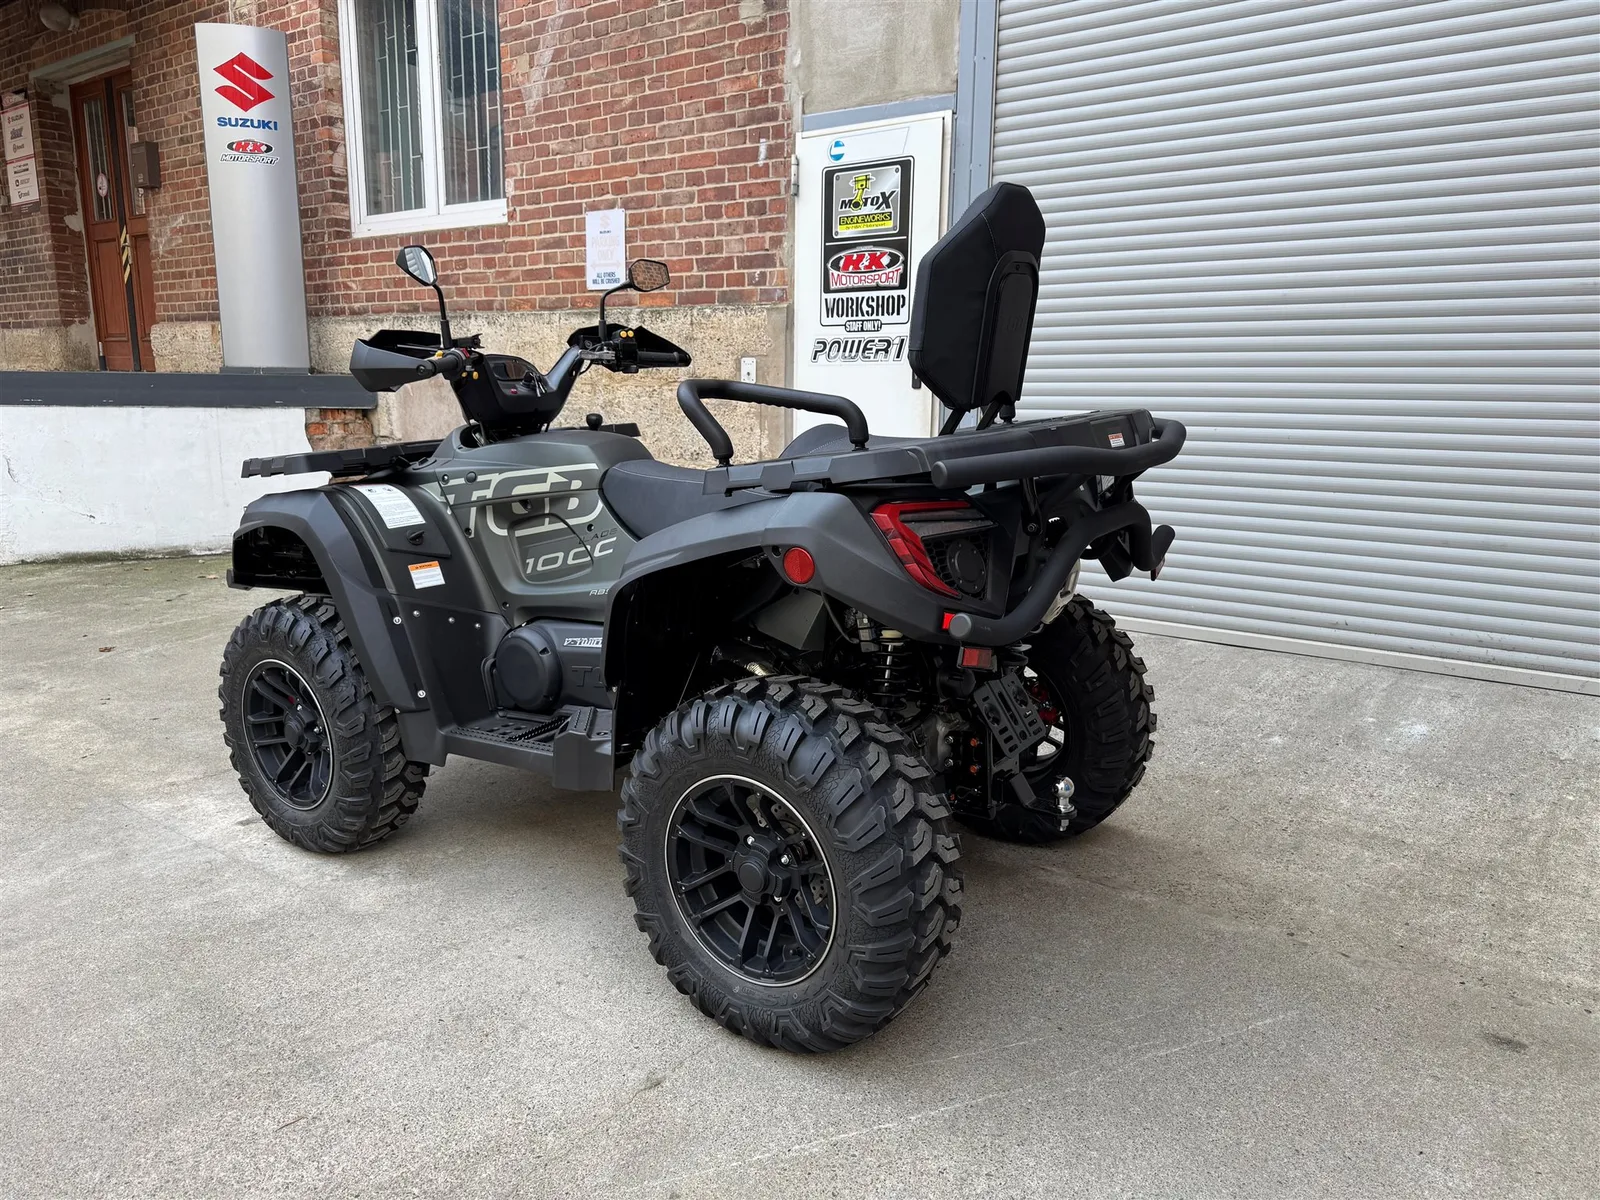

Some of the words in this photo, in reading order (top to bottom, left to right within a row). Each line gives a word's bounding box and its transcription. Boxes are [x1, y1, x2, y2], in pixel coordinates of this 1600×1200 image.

[217, 116, 278, 131] SUZUKI
[220, 153, 280, 166] MOTORSPORT
[840, 212, 891, 225] ENGINEWORKS
[841, 251, 889, 272] H&K
[831, 267, 903, 287] MOTORSPORT
[825, 294, 906, 319] WORKSHOP
[846, 320, 862, 332] STAFF
[863, 319, 881, 331] ONLY!
